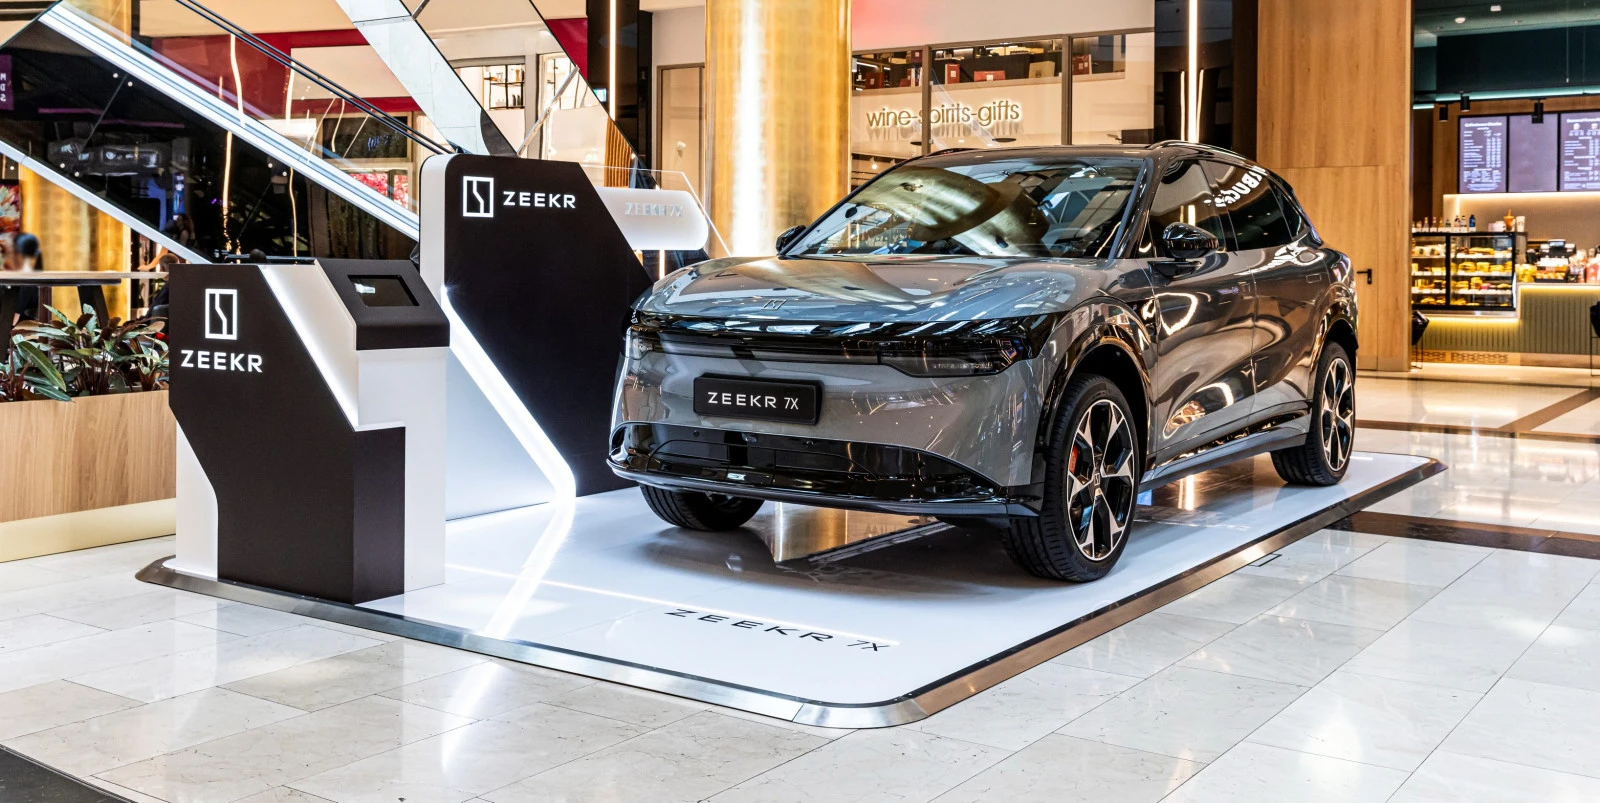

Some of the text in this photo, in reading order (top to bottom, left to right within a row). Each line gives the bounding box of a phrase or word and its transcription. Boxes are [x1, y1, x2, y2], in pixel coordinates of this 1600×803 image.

[503, 190, 576, 209] ZEEKR
[624, 202, 666, 216] ZEEKR
[181, 349, 263, 373] ZEEKR
[707, 391, 799, 410] ZEEKR 7X
[664, 608, 891, 652] ZEEKR 7X
